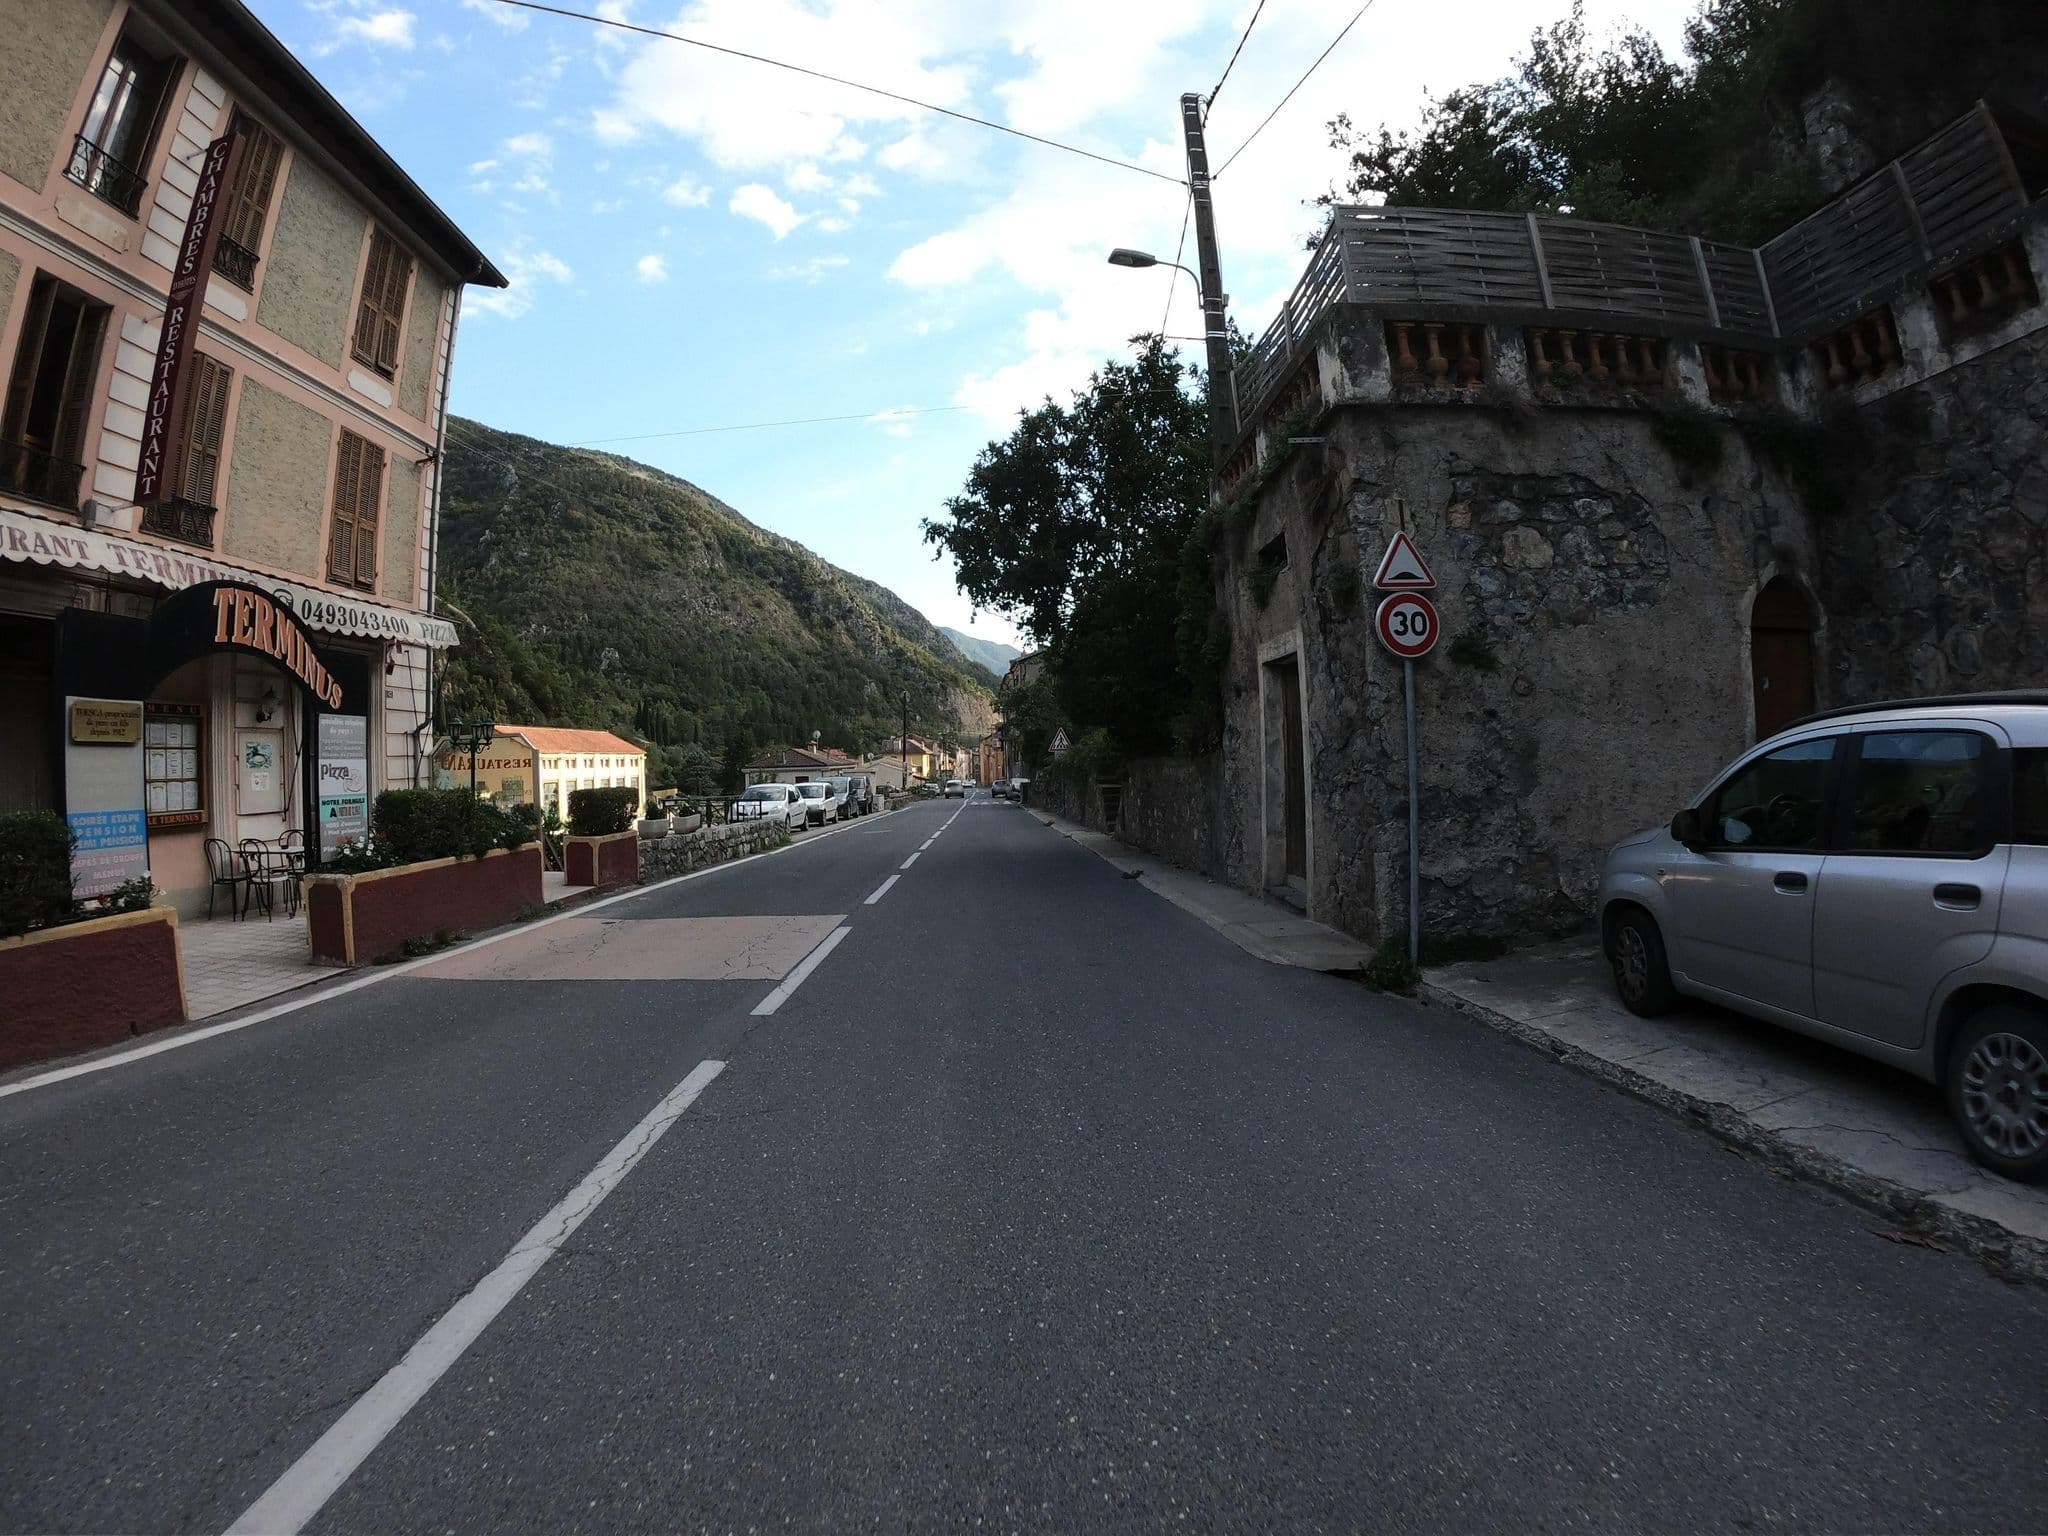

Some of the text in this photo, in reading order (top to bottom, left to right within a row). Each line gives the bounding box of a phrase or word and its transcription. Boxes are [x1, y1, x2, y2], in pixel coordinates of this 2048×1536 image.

[183, 141, 228, 275] CHAMBRES
[141, 307, 185, 495] RESTAURANT
[302, 599, 410, 635] 0493043400
[1393, 611, 1427, 636] 30
[213, 587, 343, 710] TERMINUS
[147, 703, 200, 714] MENU
[321, 764, 351, 780] Pizza
[160, 813, 201, 825] TERMINUS
[330, 807, 338, 818] A
[76, 825, 138, 838] PENSION
[101, 835, 144, 848] PENSION
